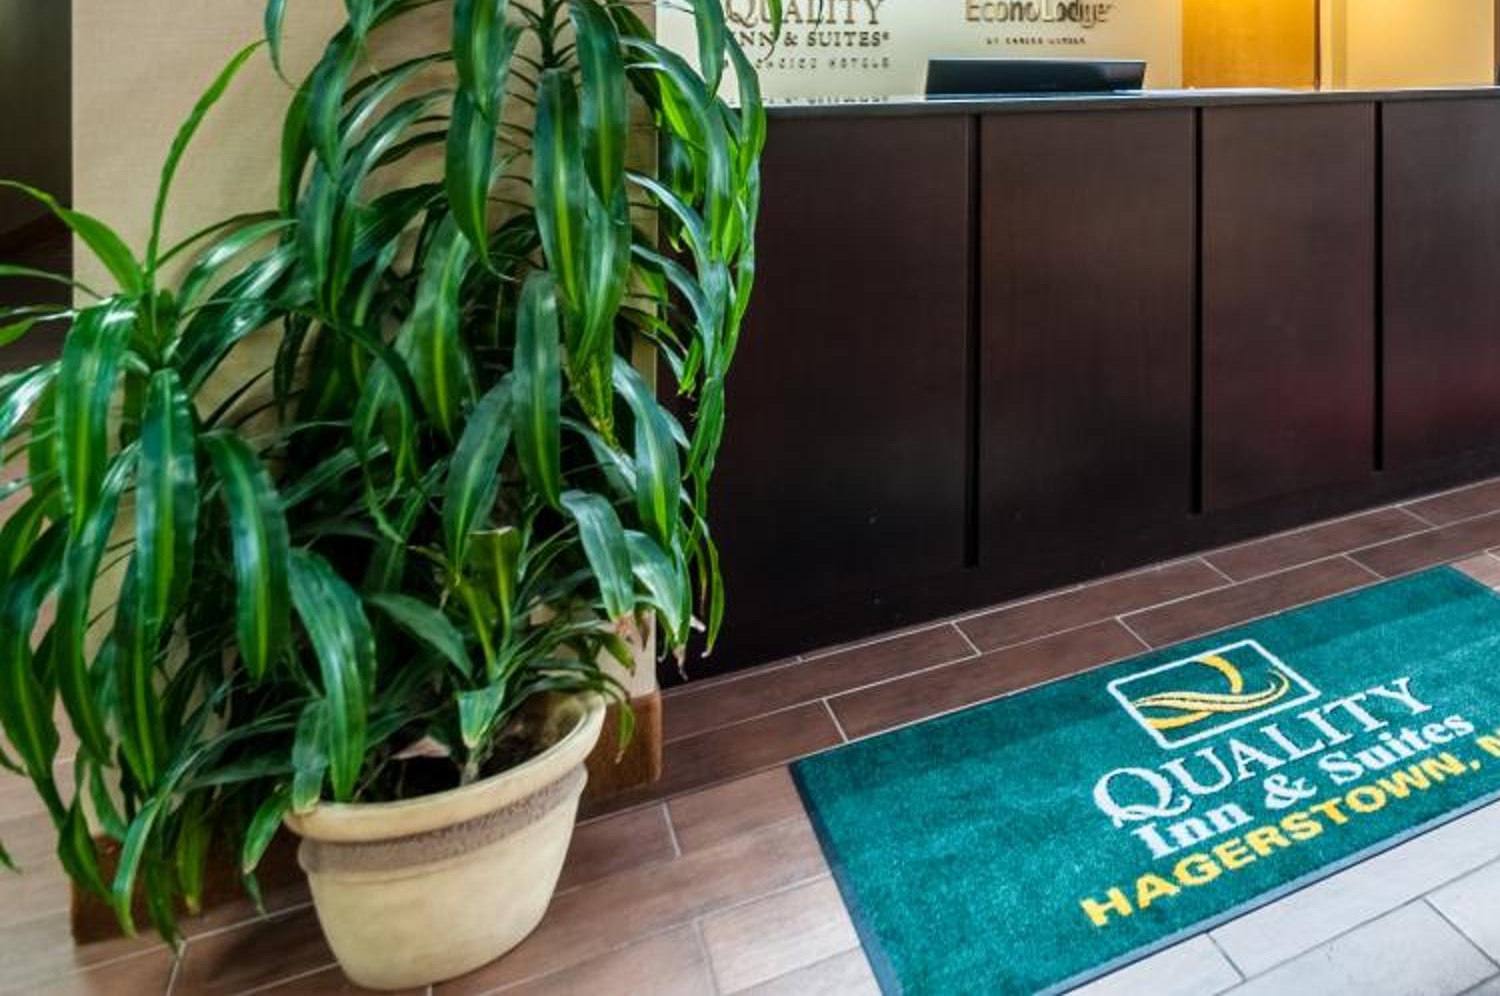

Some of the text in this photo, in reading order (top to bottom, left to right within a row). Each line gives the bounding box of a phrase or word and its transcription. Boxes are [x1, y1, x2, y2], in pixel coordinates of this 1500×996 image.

[783, 30, 799, 47] &
[1093, 677, 1432, 829] QUALITY
[1131, 714, 1475, 860] Inn & Suites
[1080, 751, 1481, 926] HAGERSTOWN,
